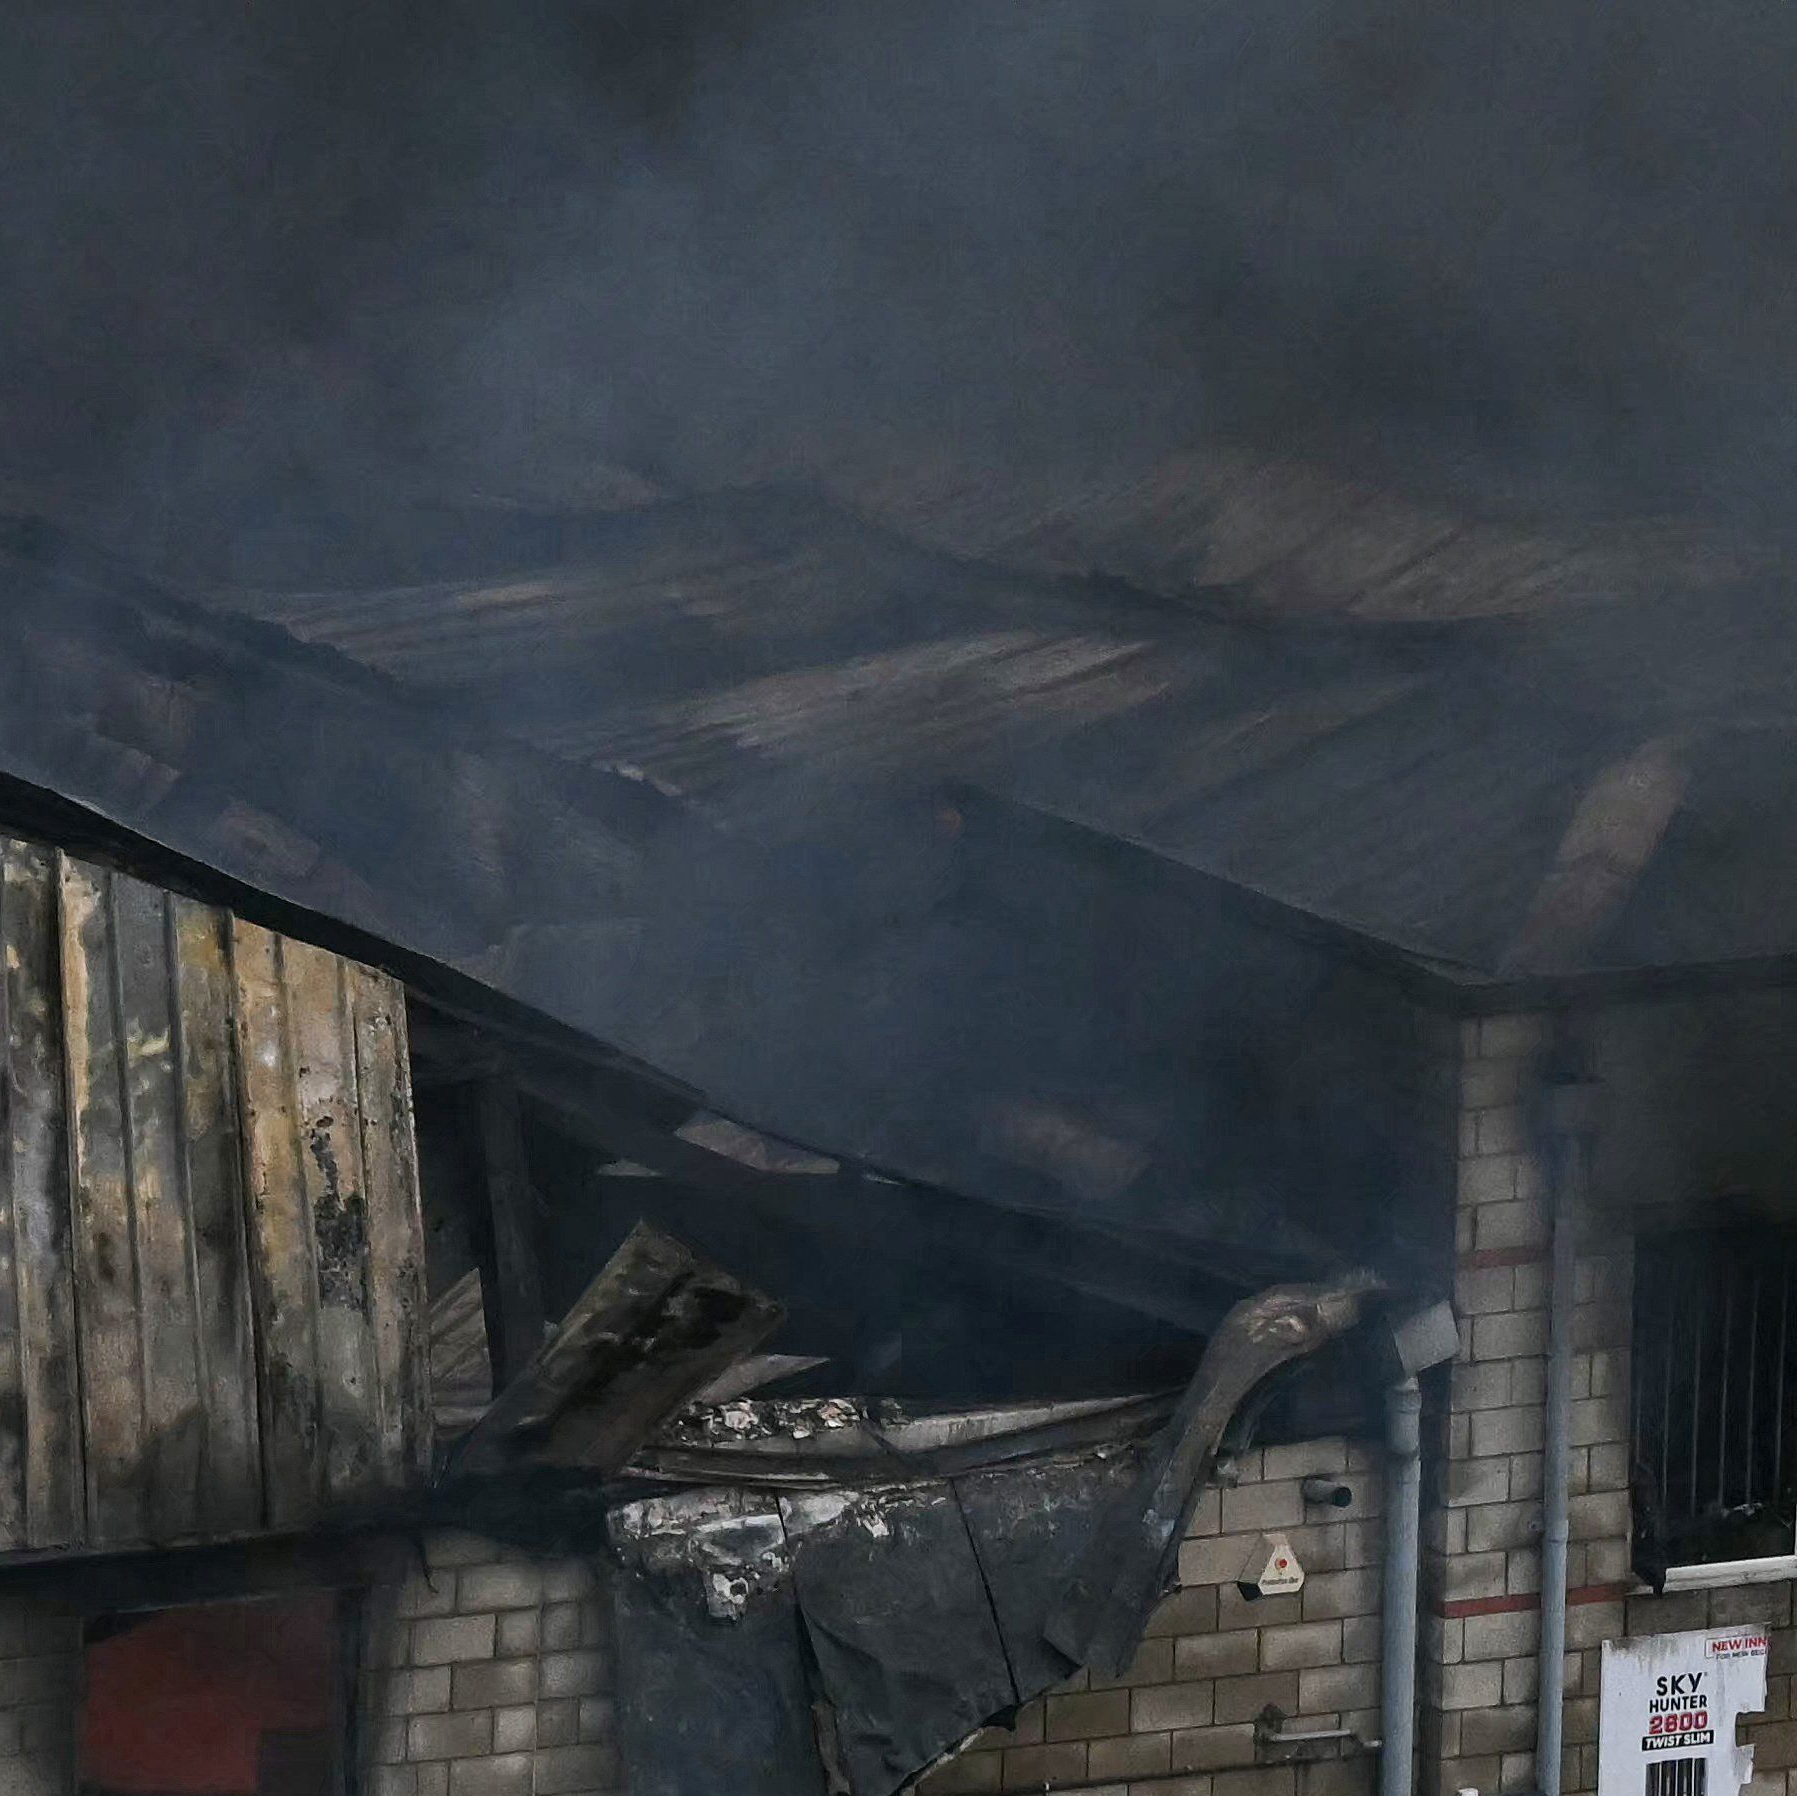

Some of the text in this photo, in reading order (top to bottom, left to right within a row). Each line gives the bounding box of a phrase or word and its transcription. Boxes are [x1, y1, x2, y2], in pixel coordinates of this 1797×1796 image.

[1712, 1639, 1742, 1652] NEW
[1656, 1672, 1703, 1697] SKY
[1649, 1695, 1708, 1714] HUNTER
[1645, 1730, 1711, 1750] TWIST SLIM
